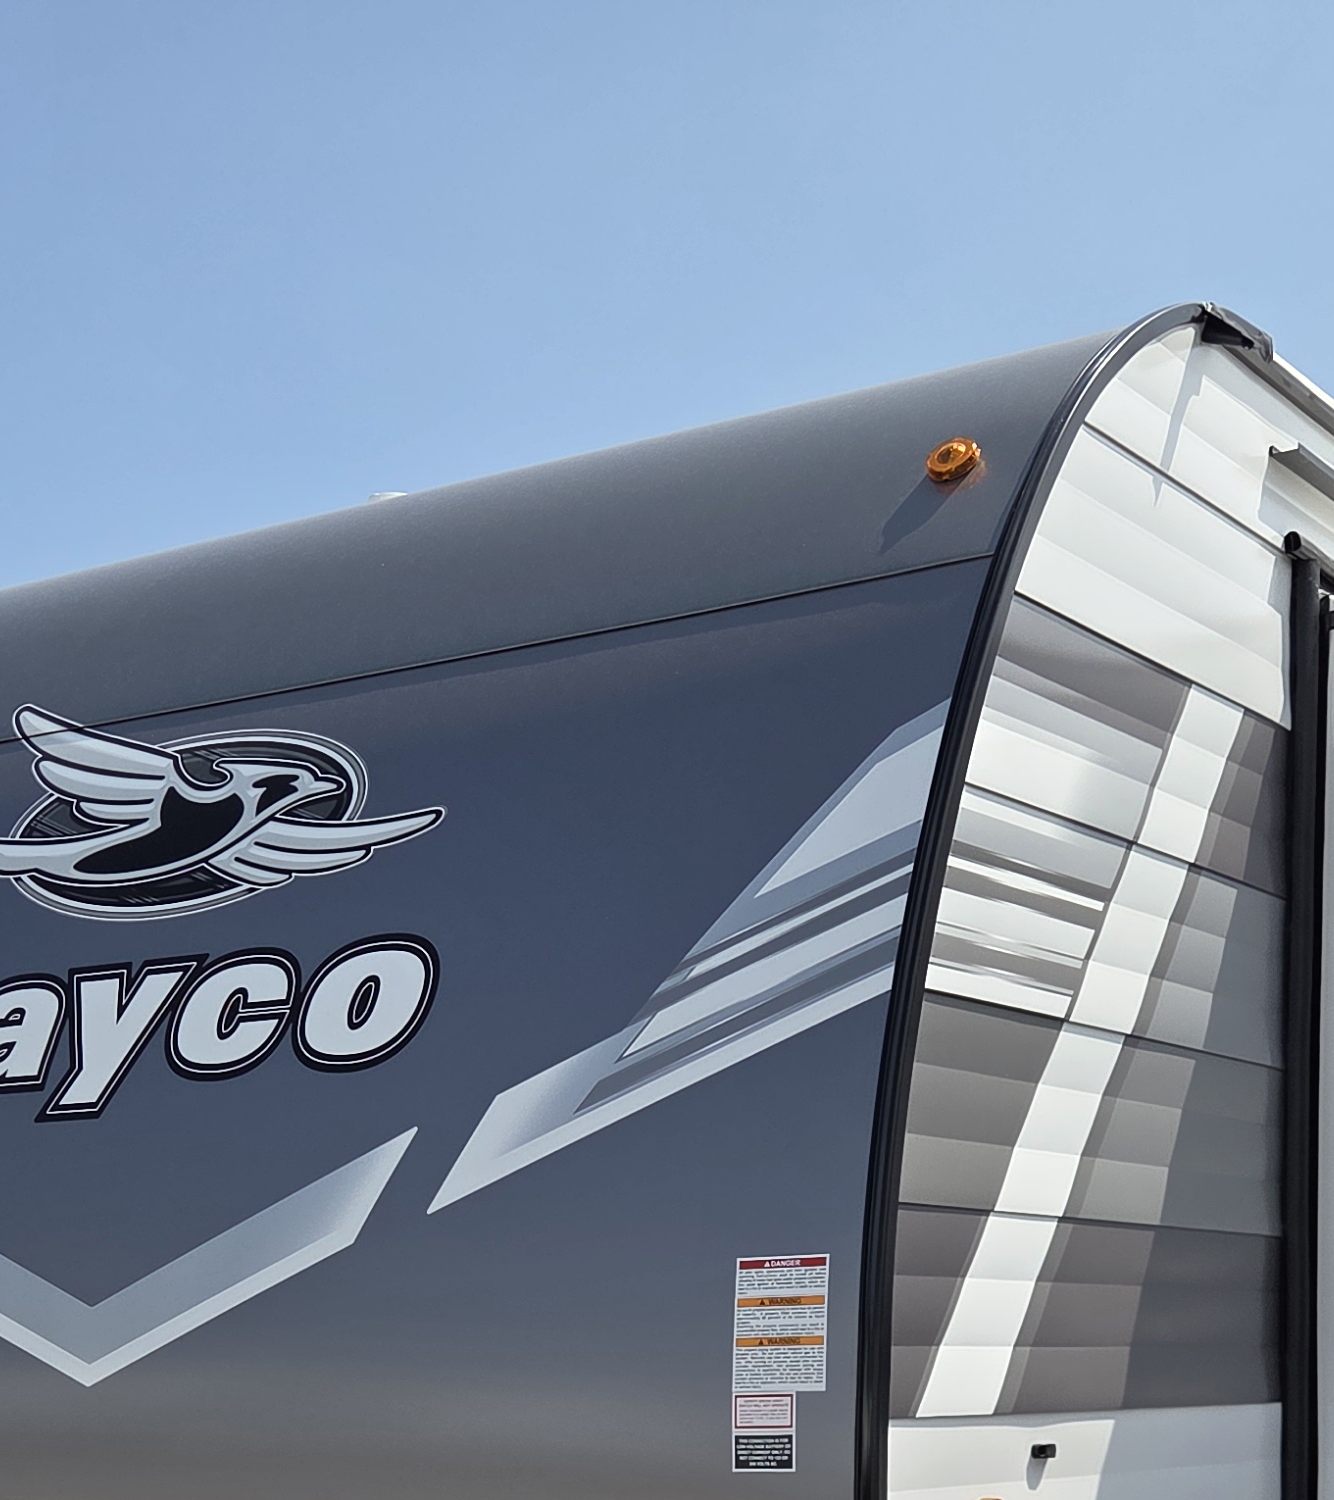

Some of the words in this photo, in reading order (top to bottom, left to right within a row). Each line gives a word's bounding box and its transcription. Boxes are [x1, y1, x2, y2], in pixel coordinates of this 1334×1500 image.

[770, 1259, 802, 1267] DANGER
[768, 1297, 802, 1305] WARNING
[767, 1337, 801, 1345] WARNING
